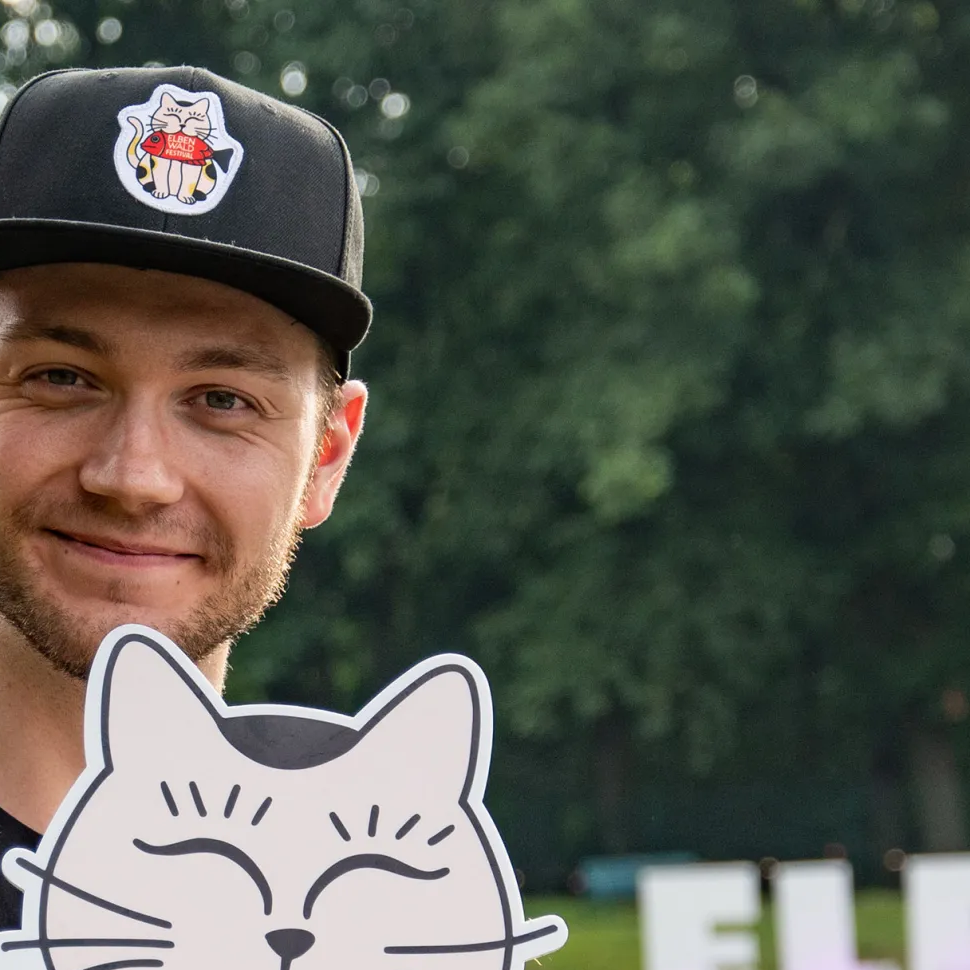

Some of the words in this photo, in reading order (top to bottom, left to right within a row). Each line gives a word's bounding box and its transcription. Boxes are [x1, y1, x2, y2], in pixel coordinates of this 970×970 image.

[168, 134, 196, 146] ELBEN
[168, 141, 195, 153] WALD
[165, 149, 194, 159] FESTIVAL
